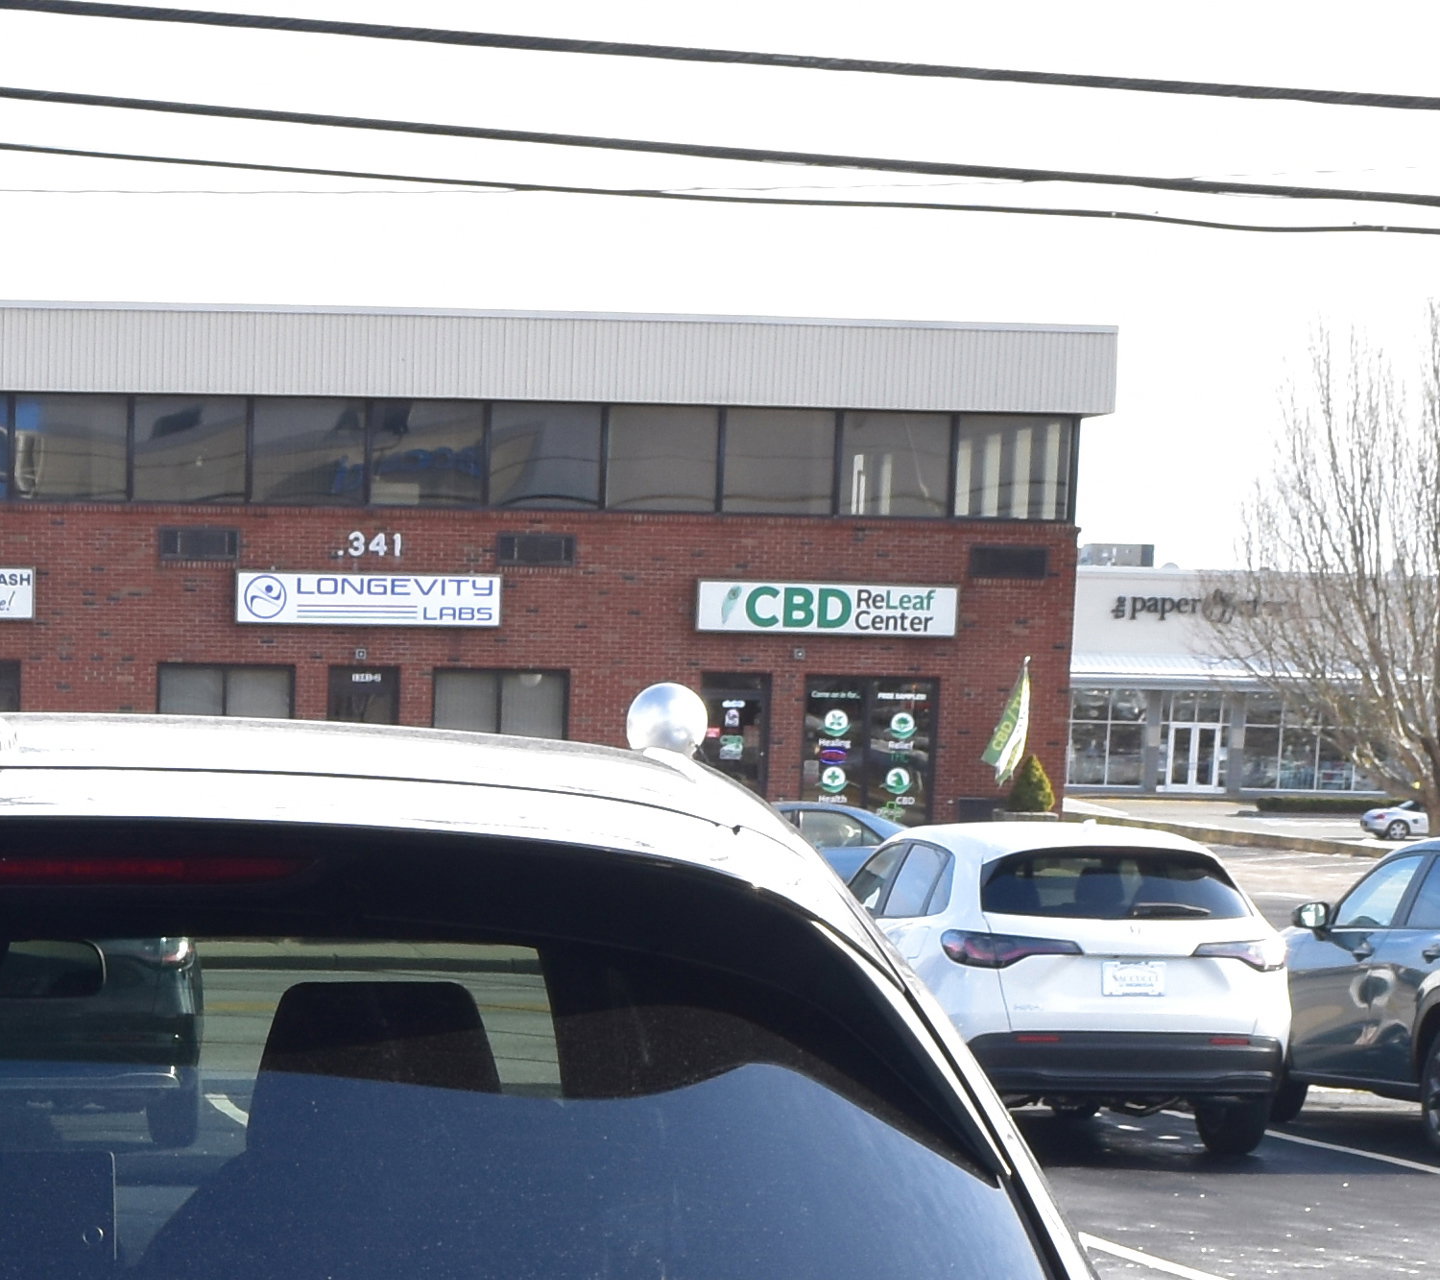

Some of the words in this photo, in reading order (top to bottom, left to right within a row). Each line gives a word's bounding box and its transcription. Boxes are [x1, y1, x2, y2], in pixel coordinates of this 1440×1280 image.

[296, 577, 494, 597] LONGEVITY
[745, 586, 852, 628] CBD
[856, 589, 936, 611] ReLeaf
[1129, 596, 1201, 620] paper
[422, 606, 493, 621] LABS
[855, 611, 933, 632] Center
[896, 796, 916, 805] CBD
